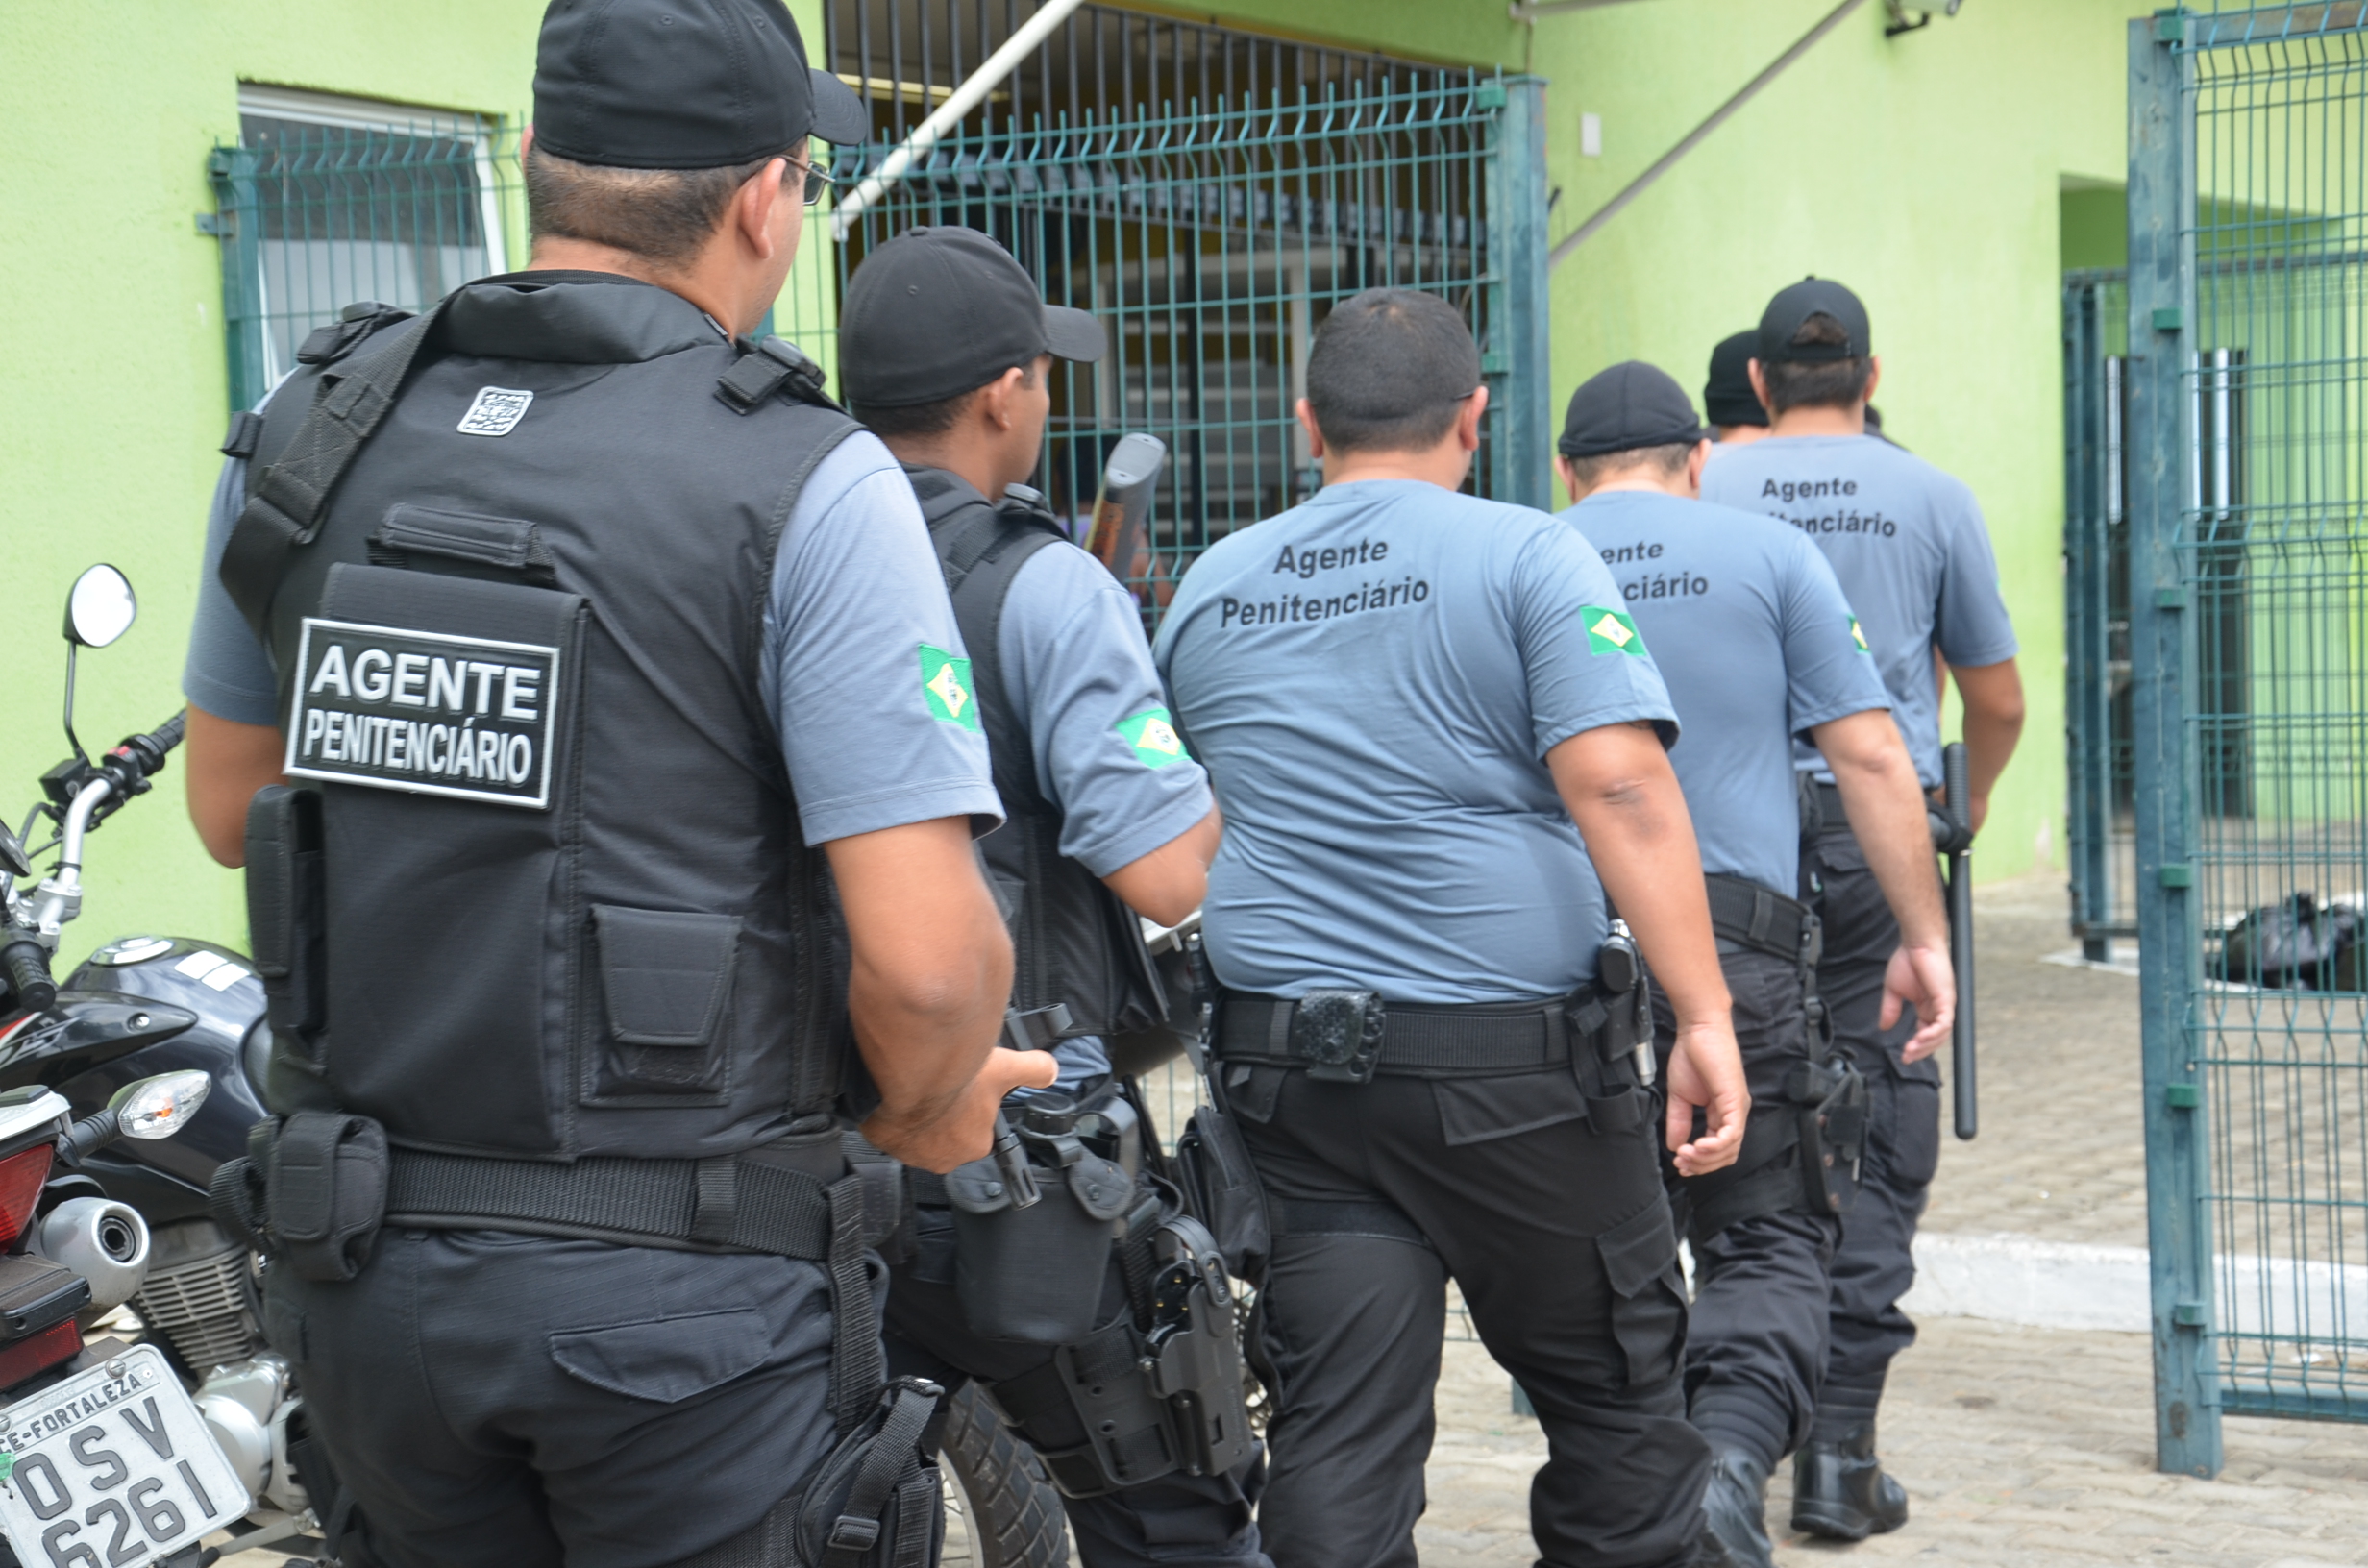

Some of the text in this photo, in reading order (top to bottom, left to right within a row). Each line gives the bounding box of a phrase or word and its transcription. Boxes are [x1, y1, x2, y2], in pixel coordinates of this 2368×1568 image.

[1762, 478, 1857, 503] Agente
[1272, 538, 1389, 579] Agente
[1599, 540, 1664, 565] ente
[1221, 576, 1430, 628] Penitenciário
[309, 645, 541, 721] AGENTE
[303, 708, 533, 785] PENITENCIÁRIO
[12, 1396, 175, 1521] OSV
[41, 1458, 218, 1568] 6261
